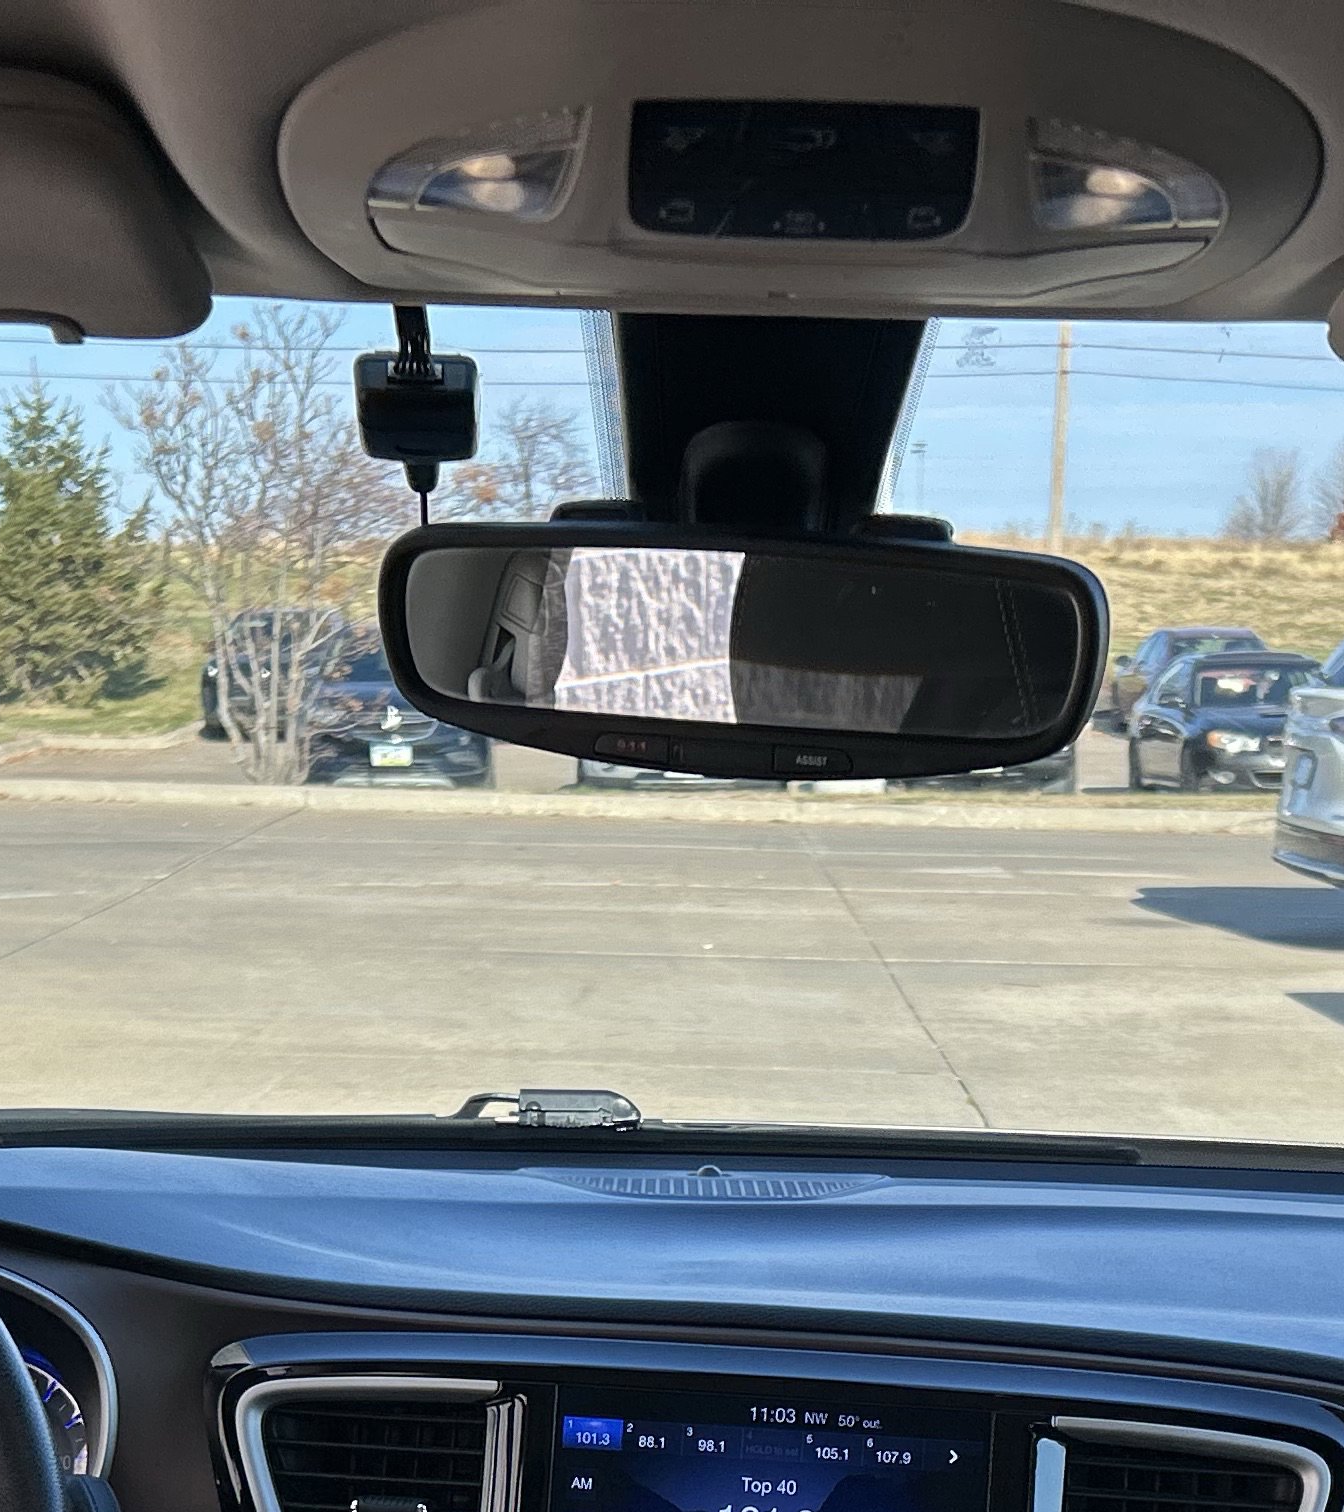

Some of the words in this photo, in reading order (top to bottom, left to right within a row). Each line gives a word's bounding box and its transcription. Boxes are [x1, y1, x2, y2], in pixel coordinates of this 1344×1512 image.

[795, 754, 828, 768] ASSIST
[750, 1406, 797, 1425] 11:03
[804, 1411, 829, 1425] NW
[568, 1419, 574, 1429] 1
[626, 1422, 634, 1433] 2
[575, 1431, 611, 1446] 101.3
[686, 1426, 694, 1437] 3
[805, 1433, 814, 1444] 5
[638, 1435, 666, 1449] 88.1
[697, 1439, 726, 1453] 98.1
[866, 1437, 874, 1448] 6
[815, 1447, 849, 1461] 105.1
[875, 1450, 912, 1465] 107.9
[570, 1476, 593, 1490] AM
[741, 1476, 772, 1497] Top
[776, 1479, 797, 1496] 40
